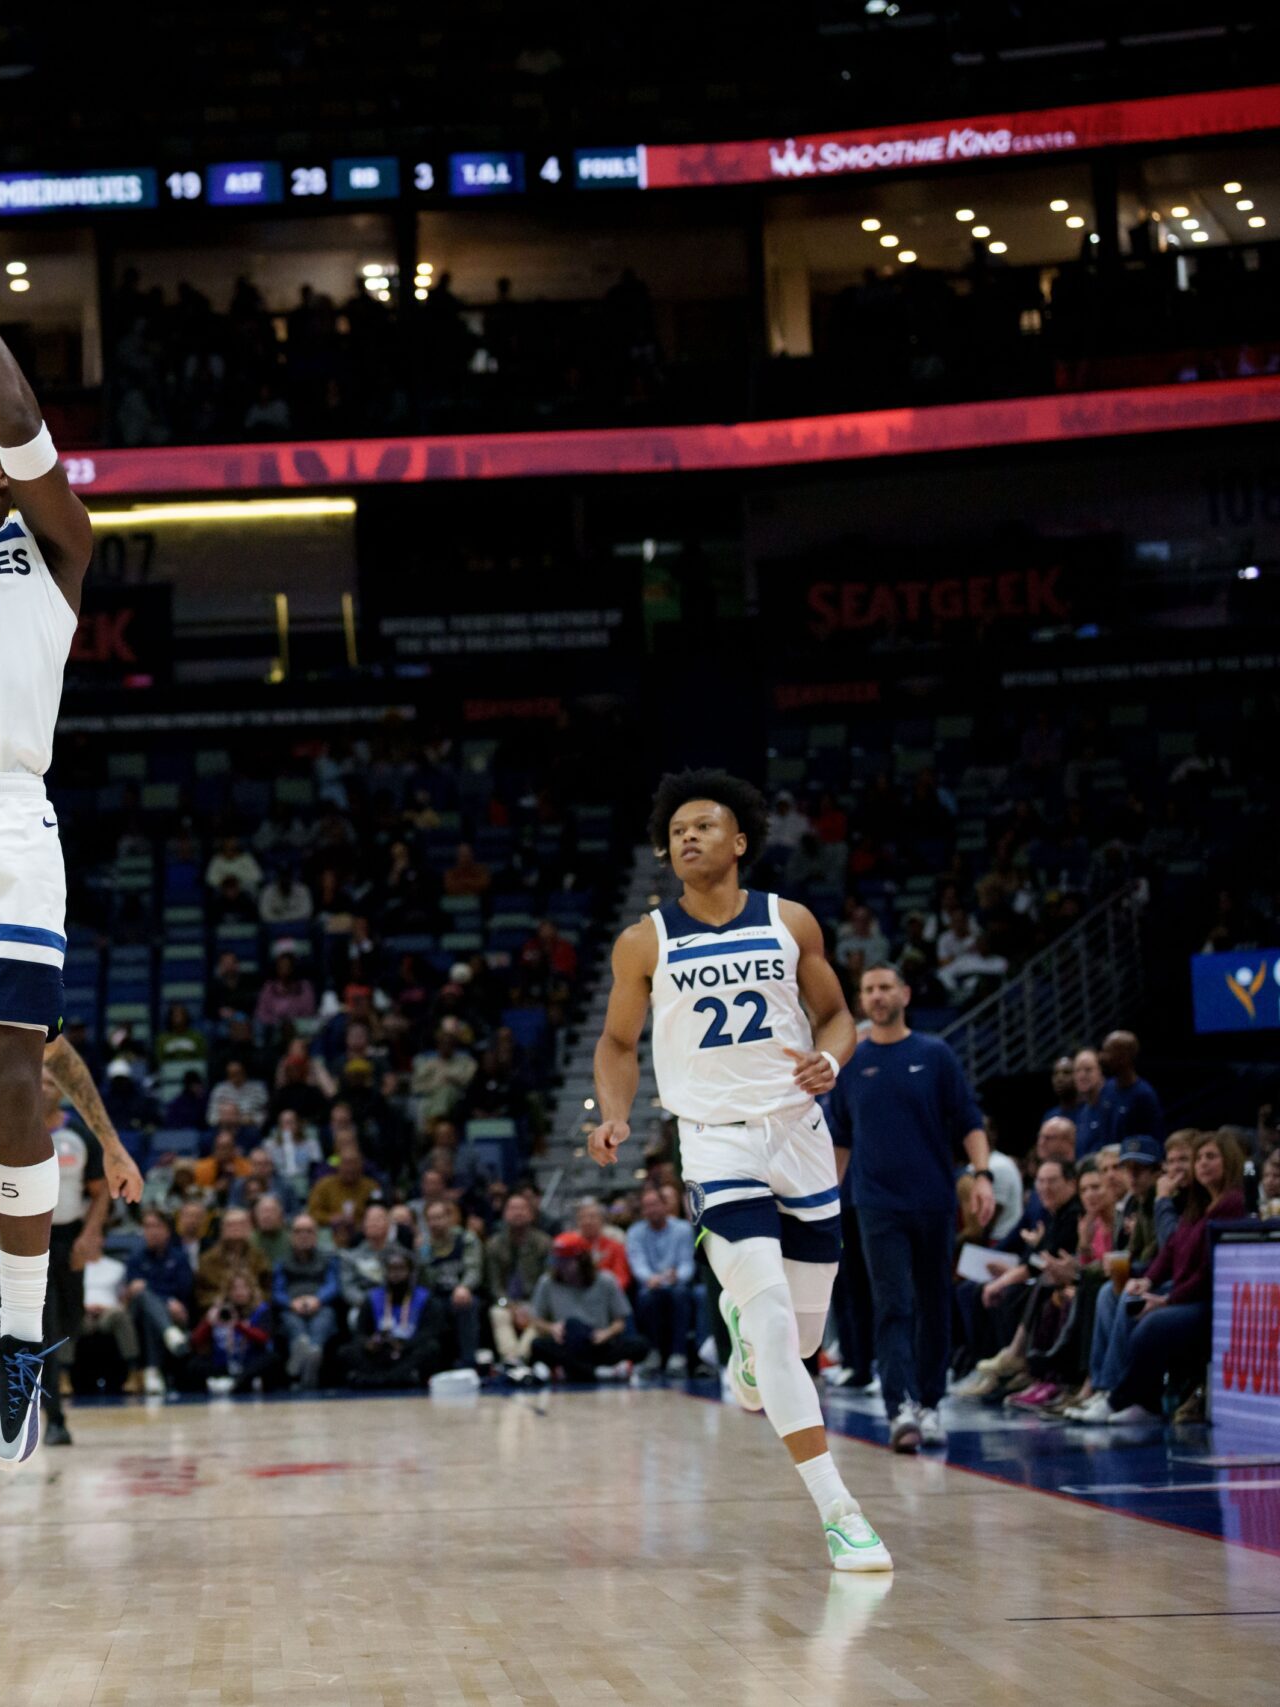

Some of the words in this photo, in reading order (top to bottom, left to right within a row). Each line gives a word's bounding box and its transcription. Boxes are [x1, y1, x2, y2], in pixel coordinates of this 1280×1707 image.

[414, 162, 435, 190] 3
[540, 156, 562, 184] 4
[670, 958, 785, 993] WOLVES
[693, 990, 773, 1049] 22
[1, 1182, 20, 1199] 5
